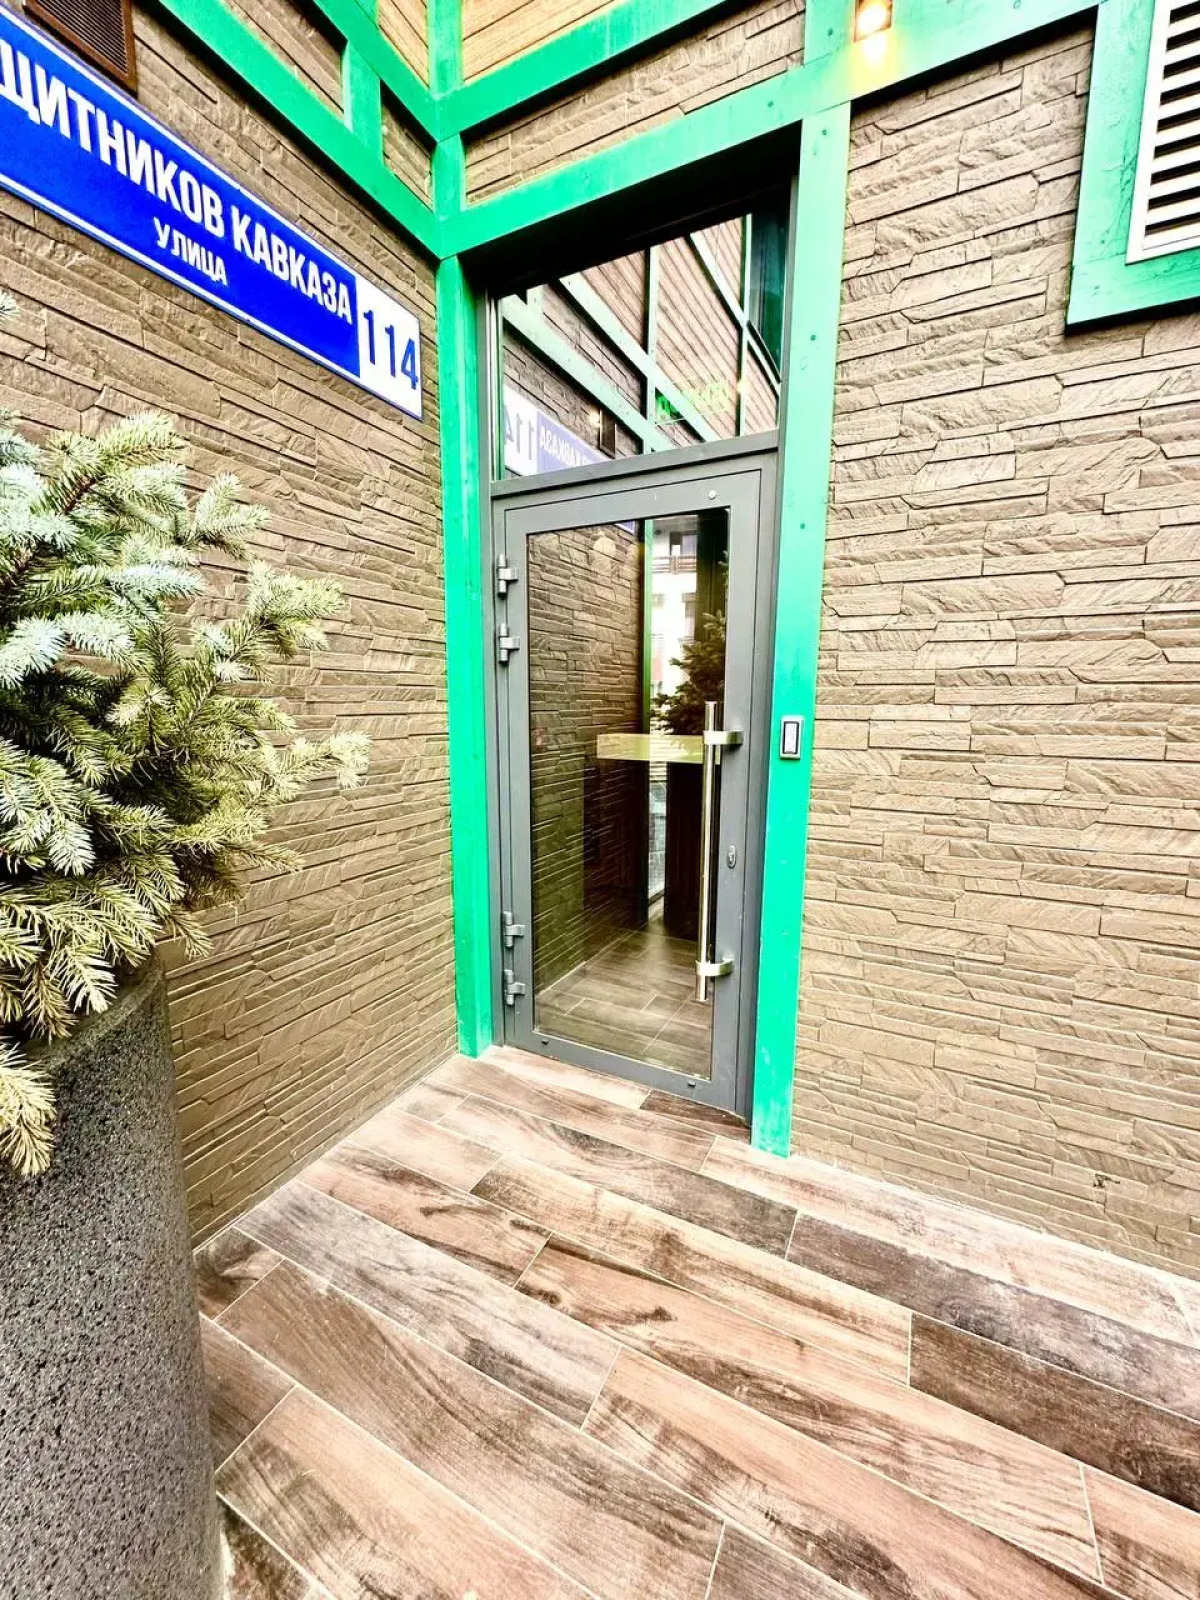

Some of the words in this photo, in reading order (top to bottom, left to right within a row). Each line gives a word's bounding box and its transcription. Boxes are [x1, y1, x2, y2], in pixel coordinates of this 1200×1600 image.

[154, 216, 228, 286] УЛИЦА
[231, 205, 353, 324] КАВКАЗА
[363, 310, 418, 390] 114
